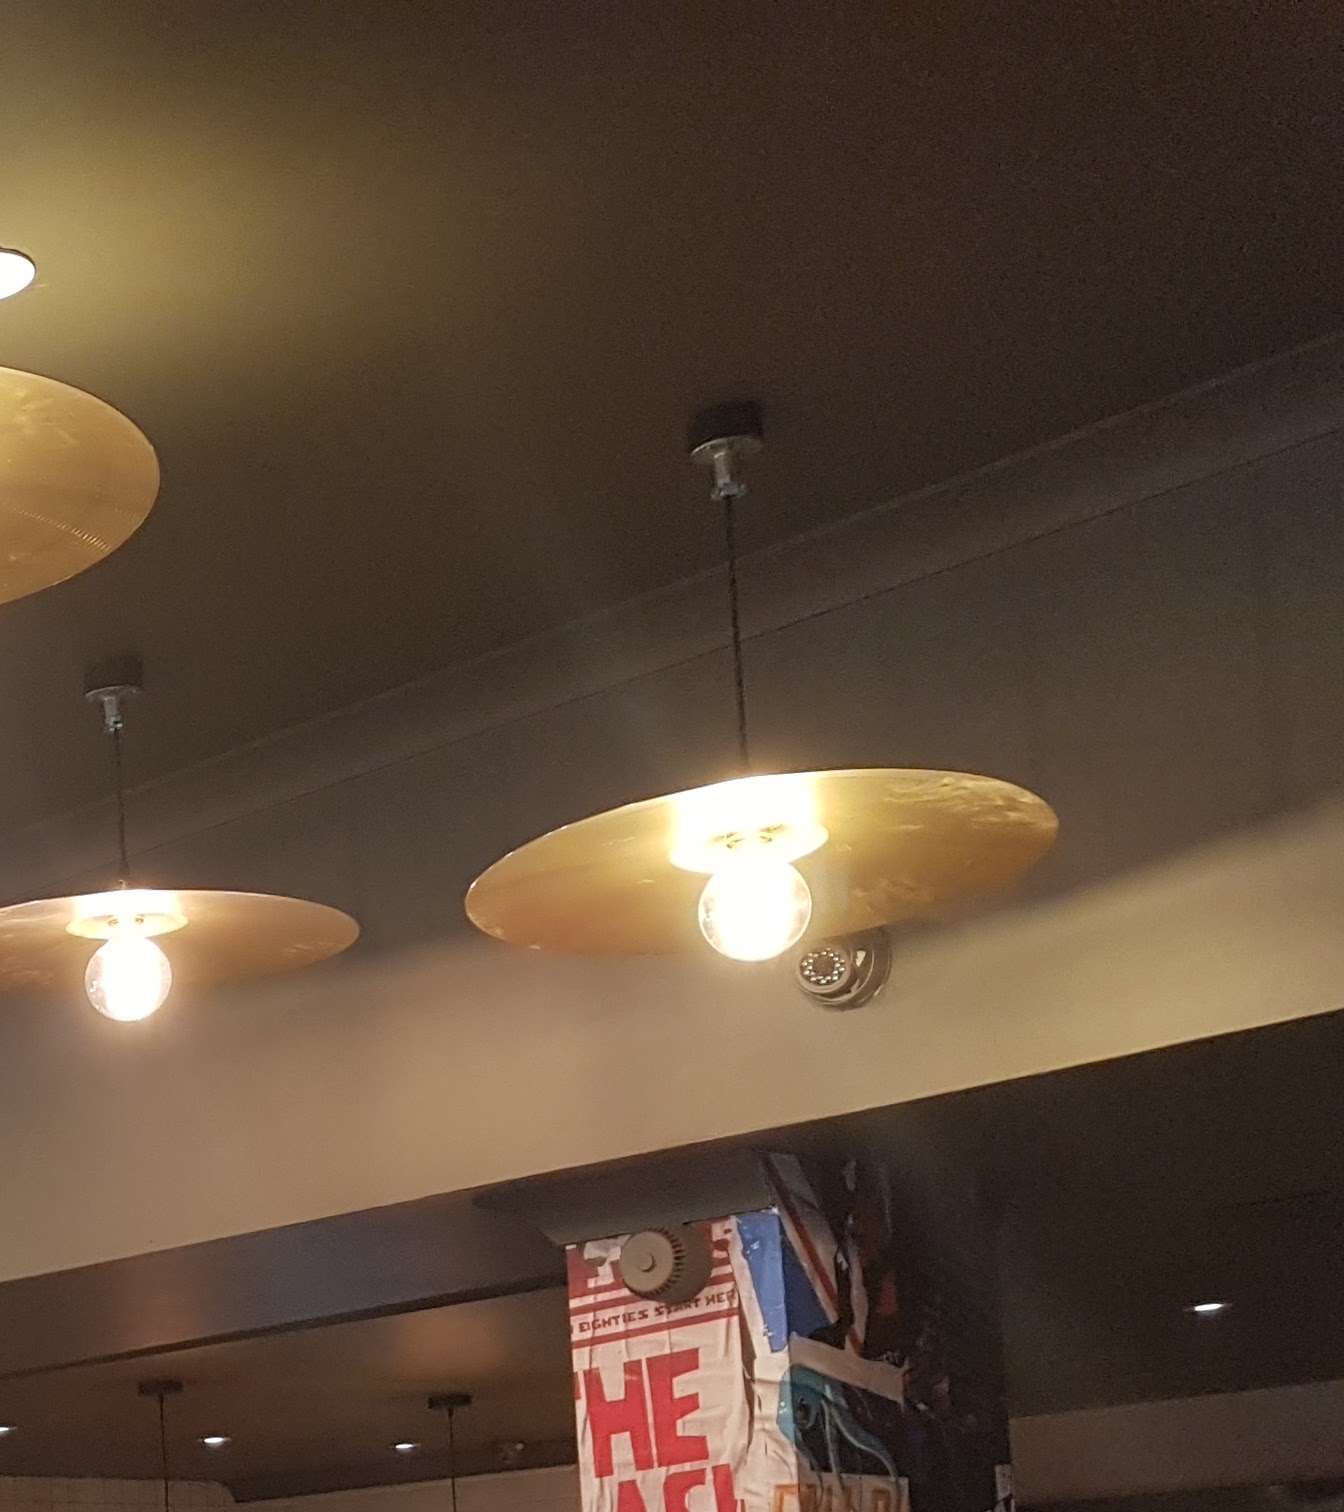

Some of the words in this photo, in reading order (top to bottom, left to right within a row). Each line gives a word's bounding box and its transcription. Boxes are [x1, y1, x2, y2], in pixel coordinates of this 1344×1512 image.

[578, 1308, 649, 1333] EIGHTIES
[705, 1290, 737, 1306] HER
[574, 1347, 710, 1479] HE
